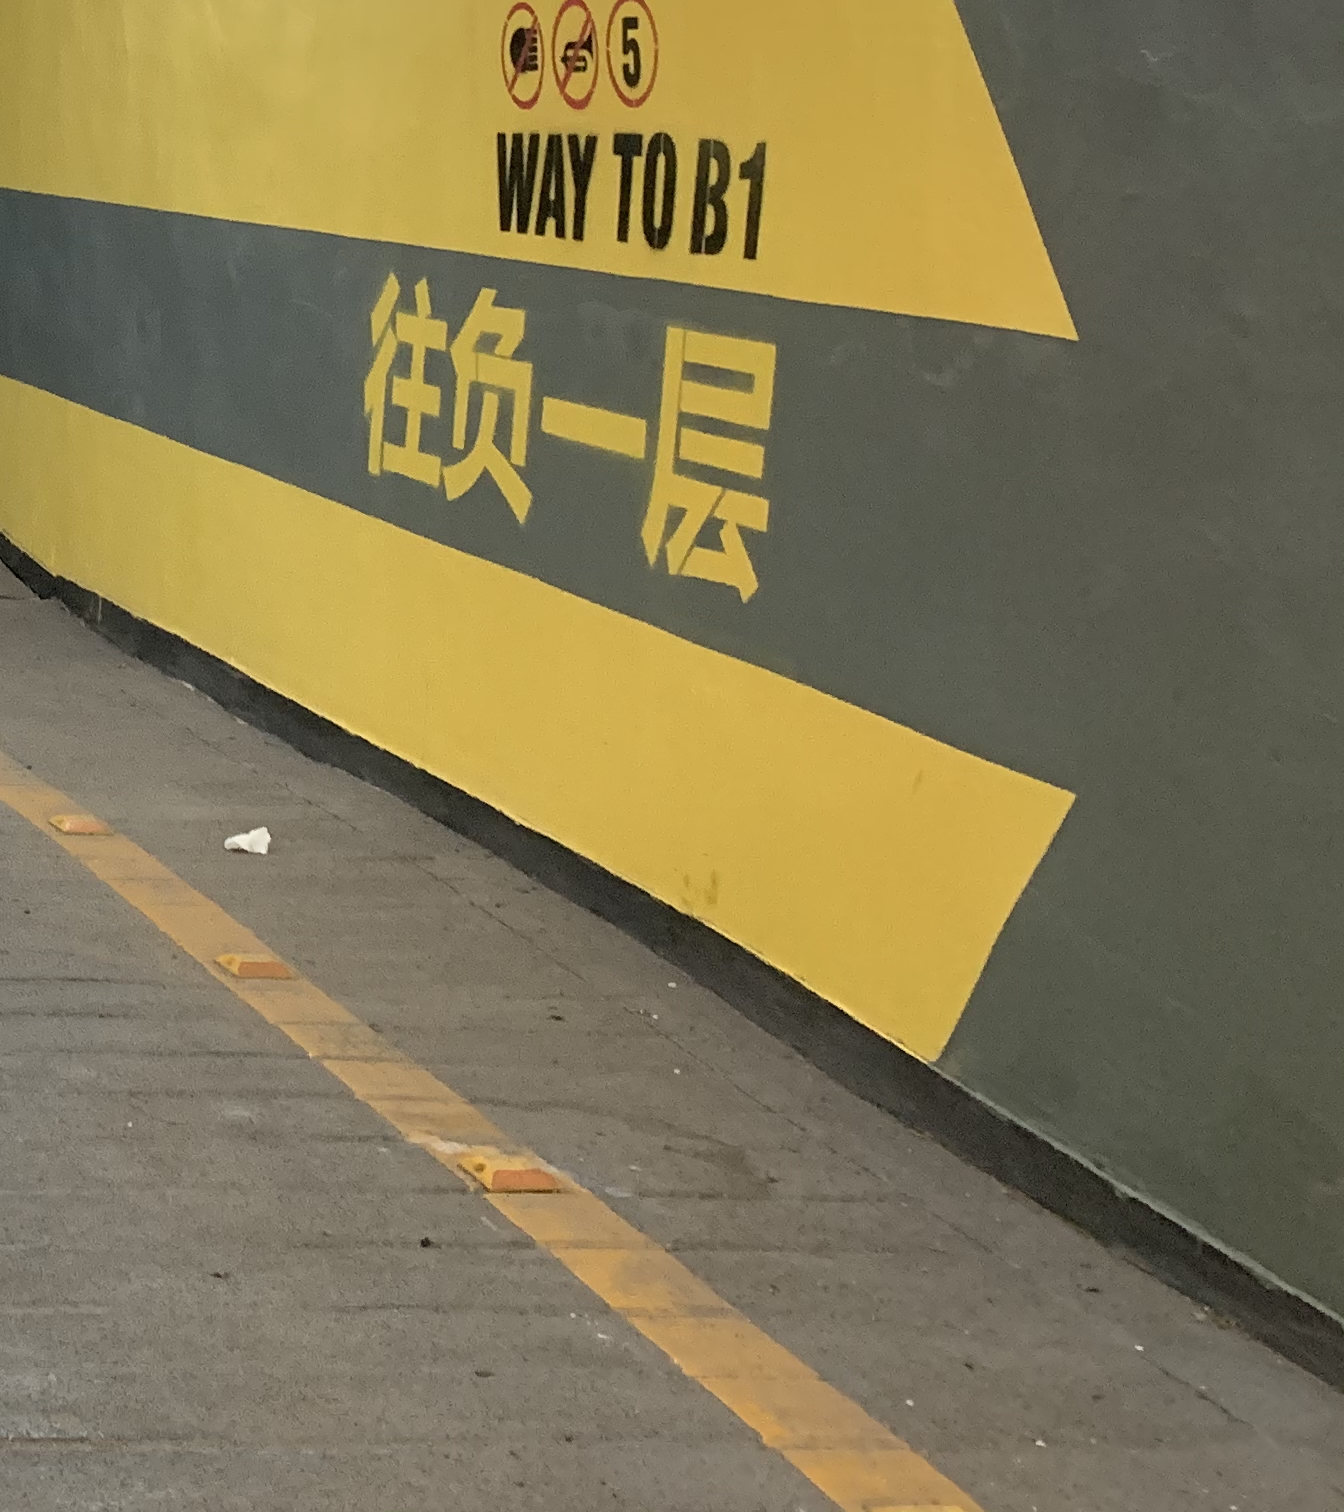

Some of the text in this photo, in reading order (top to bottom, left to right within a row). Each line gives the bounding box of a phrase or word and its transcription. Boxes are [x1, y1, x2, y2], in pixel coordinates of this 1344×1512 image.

[620, 16, 641, 88] 5
[497, 132, 766, 260] WAY TO B1
[364, 271, 776, 604] 往负一层
